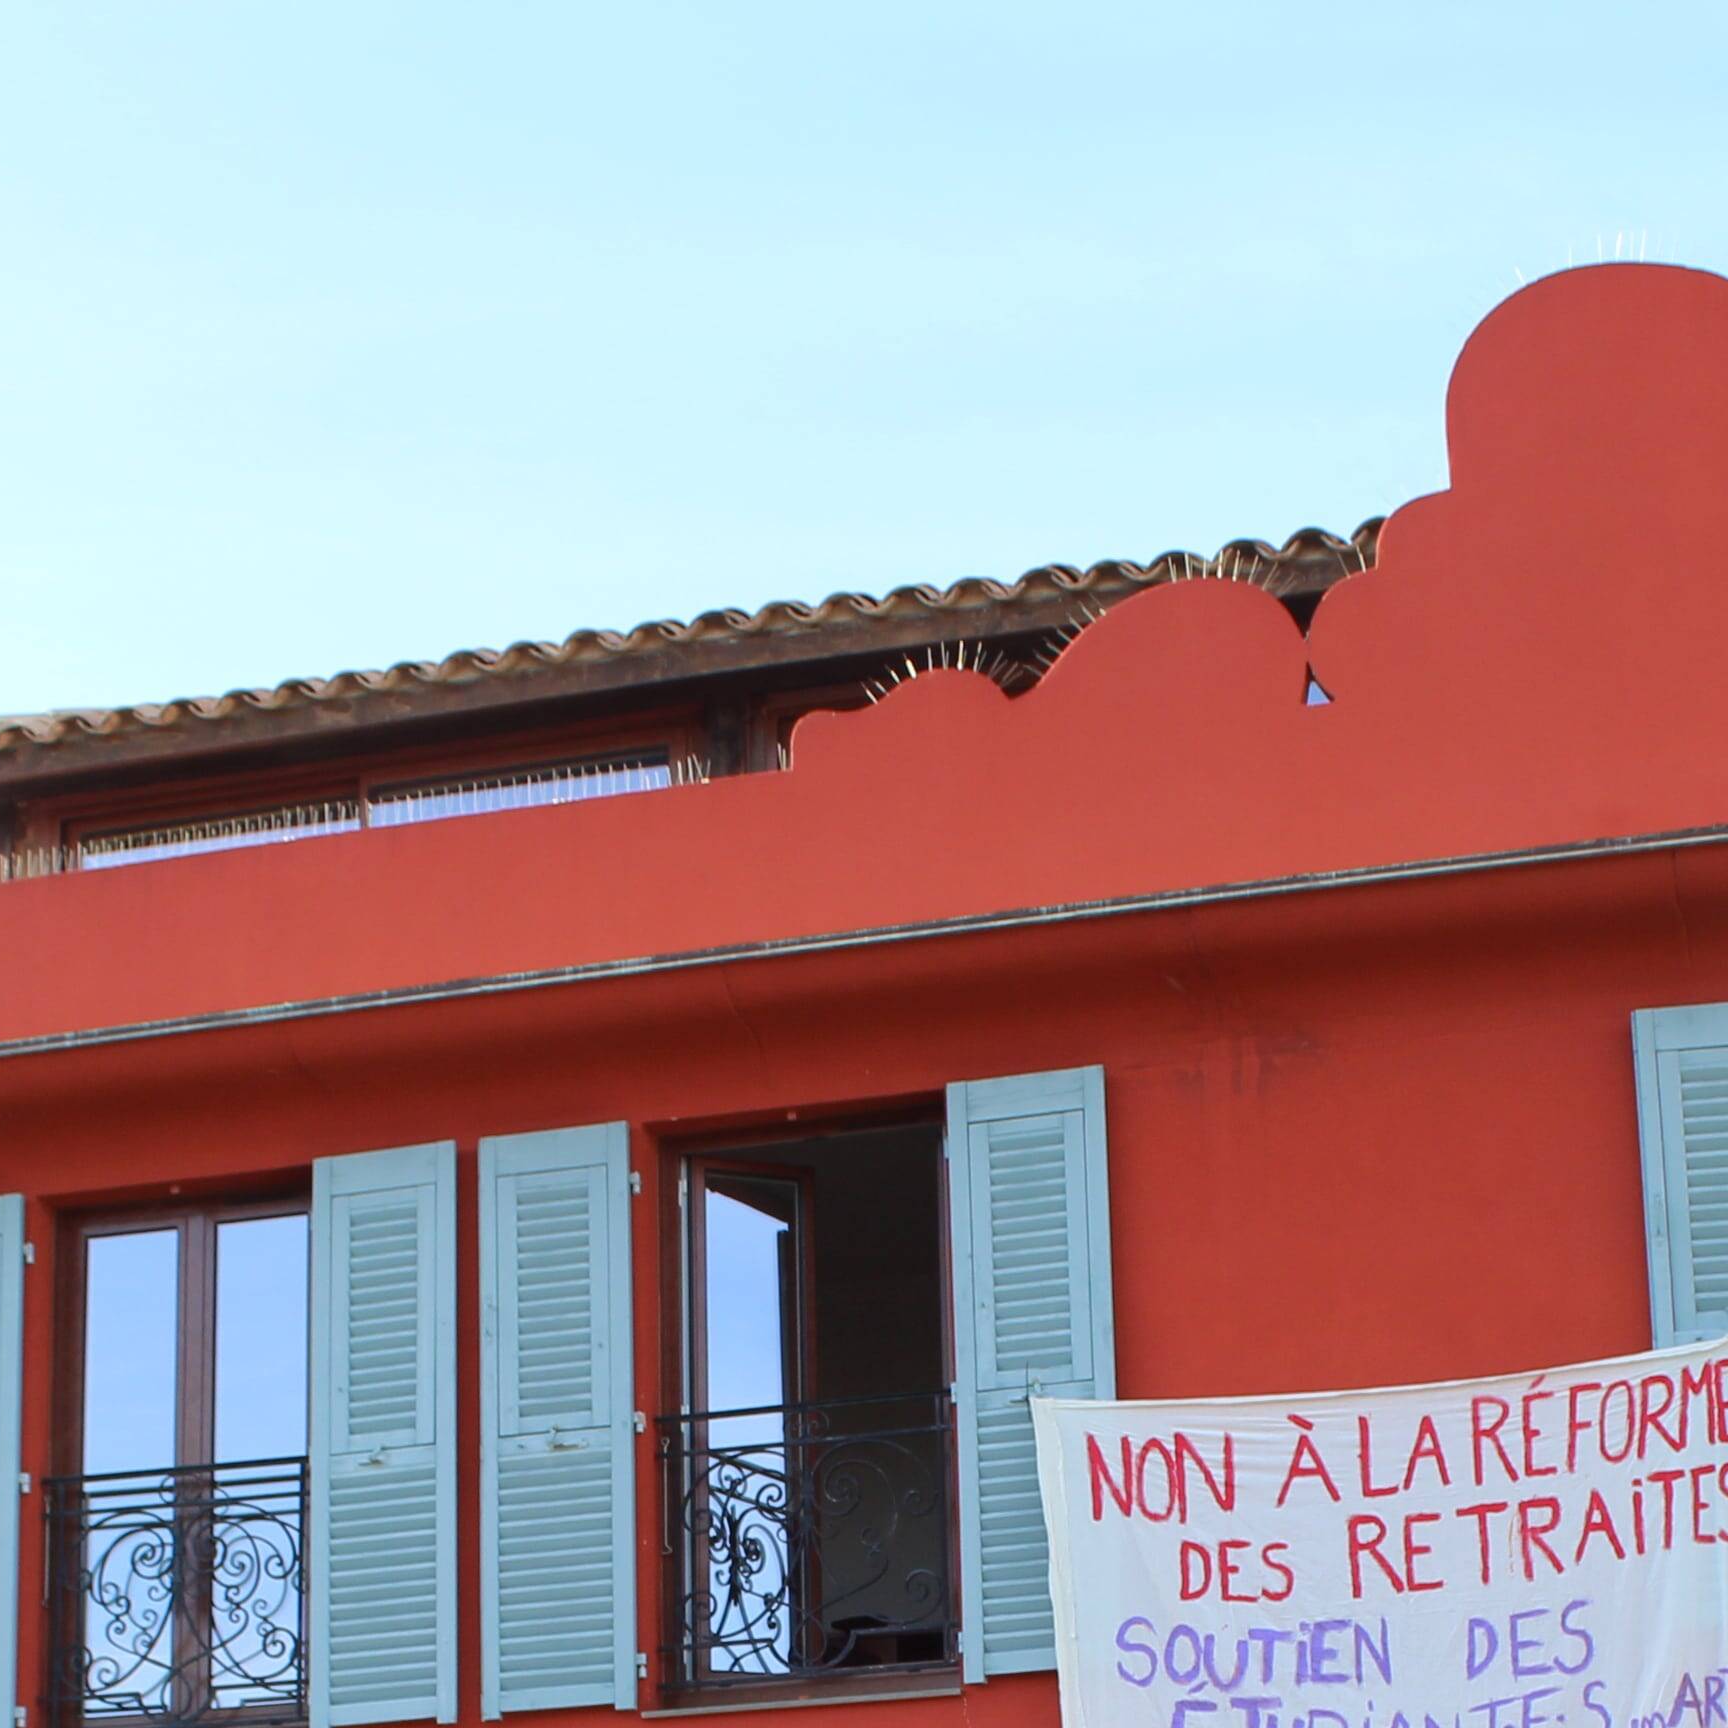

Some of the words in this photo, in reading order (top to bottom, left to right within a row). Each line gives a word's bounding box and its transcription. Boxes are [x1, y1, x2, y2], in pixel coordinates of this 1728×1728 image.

[1086, 1432, 1235, 1524] NON
[1276, 1414, 1341, 1508] À
[1357, 1415, 1451, 1497] LA
[1180, 1539, 1294, 1603] DES
[1466, 1599, 1595, 1683] DES
